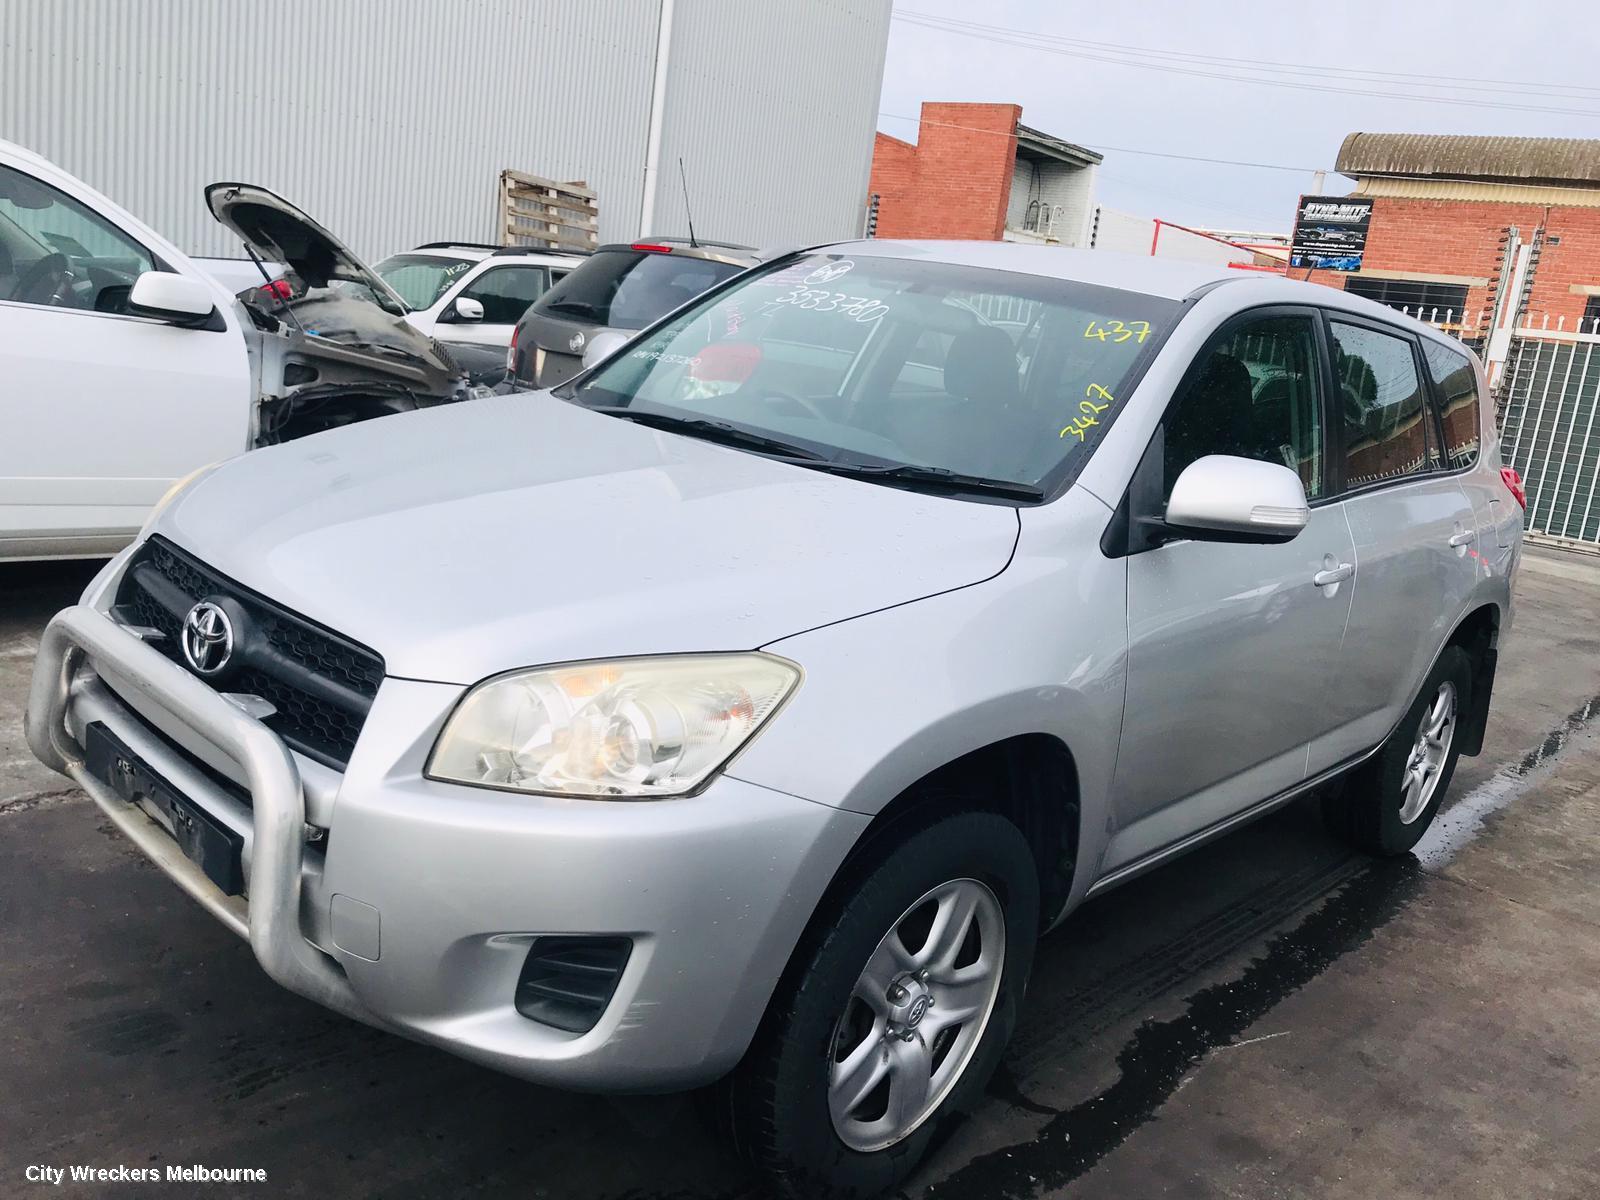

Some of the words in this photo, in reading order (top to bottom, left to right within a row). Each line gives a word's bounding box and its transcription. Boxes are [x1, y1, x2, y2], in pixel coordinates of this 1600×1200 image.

[1304, 203, 1370, 217] DYNO-MITE
[776, 285, 890, 322] 3533780
[1084, 320, 1152, 344] 437
[1060, 383, 1115, 442] 3427
